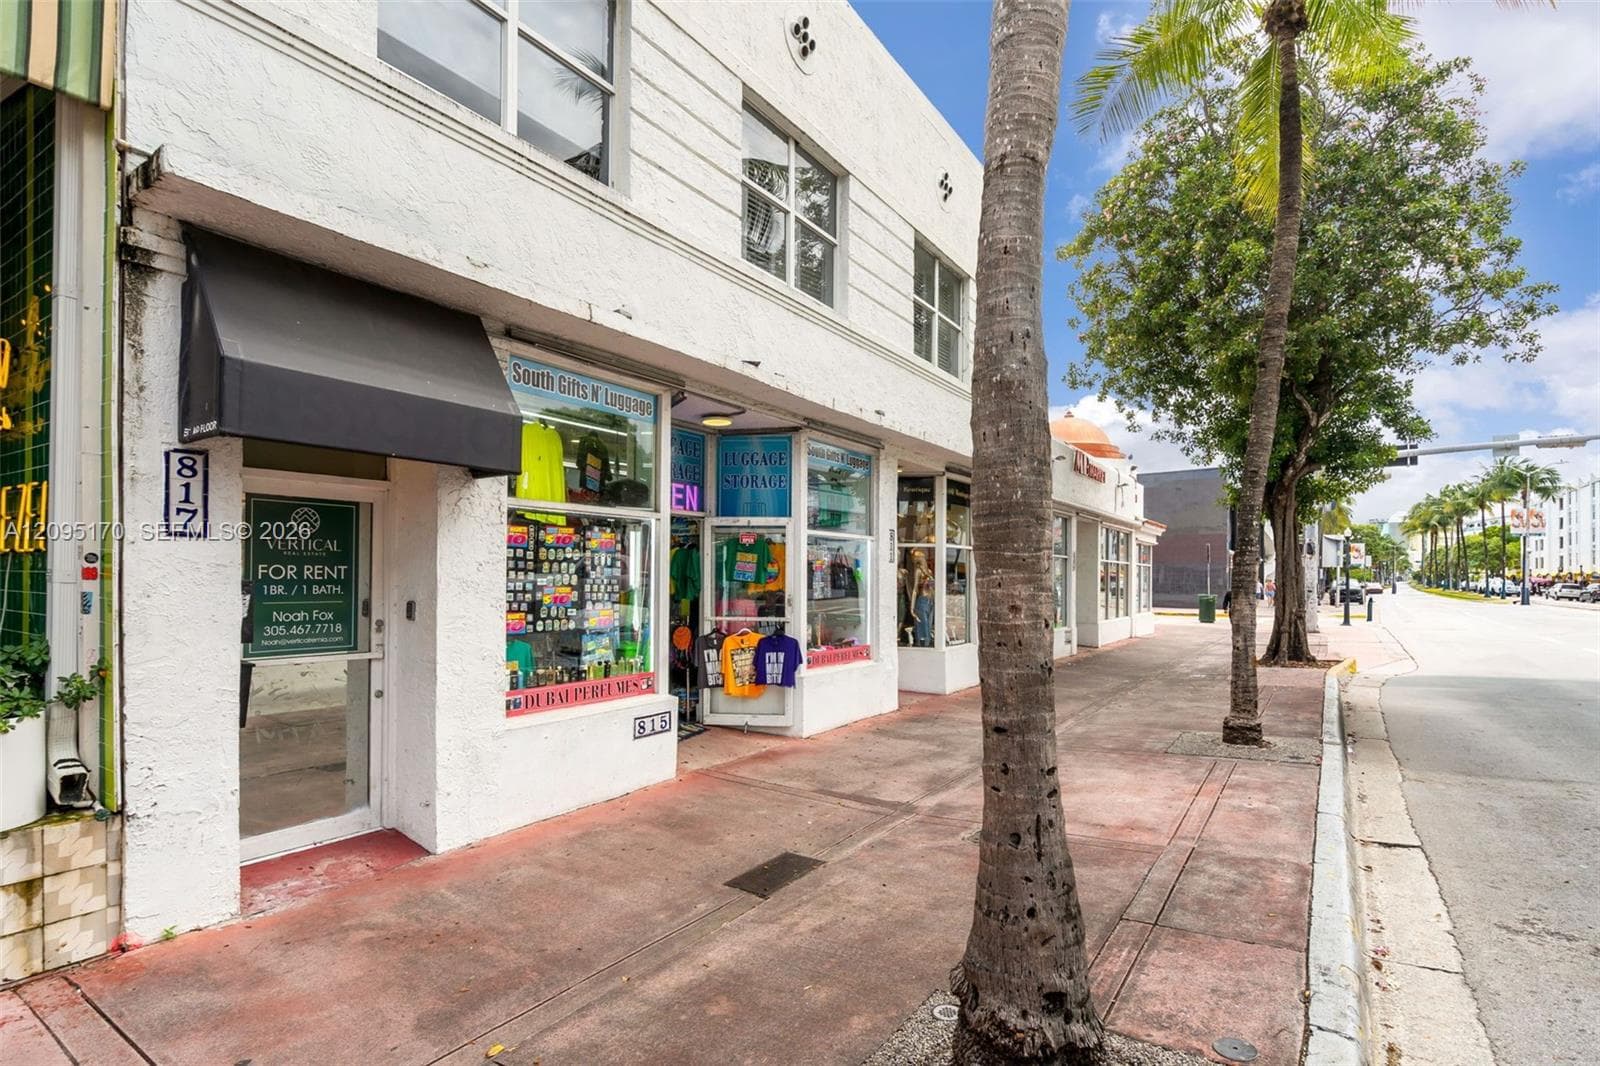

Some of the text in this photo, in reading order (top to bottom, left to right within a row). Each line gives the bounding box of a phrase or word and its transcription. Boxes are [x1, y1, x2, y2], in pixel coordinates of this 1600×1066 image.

[511, 361, 653, 416] South Gifts N' Luggage
[724, 450, 787, 467] LUGGAGE
[847, 452, 870, 471] Luggage
[723, 474, 787, 489] STORAGE
[176, 456, 198, 531] 817
[267, 538, 341, 552] VERTICAL
[258, 564, 347, 580] FOR RENT
[263, 585, 344, 595] 1BR. / 1 BATH.
[272, 610, 334, 622] Noah Fox
[263, 623, 342, 637] 305.467.7718
[524, 679, 640, 709] DUBAI PERFUMES
[637, 714, 668, 735] 815
